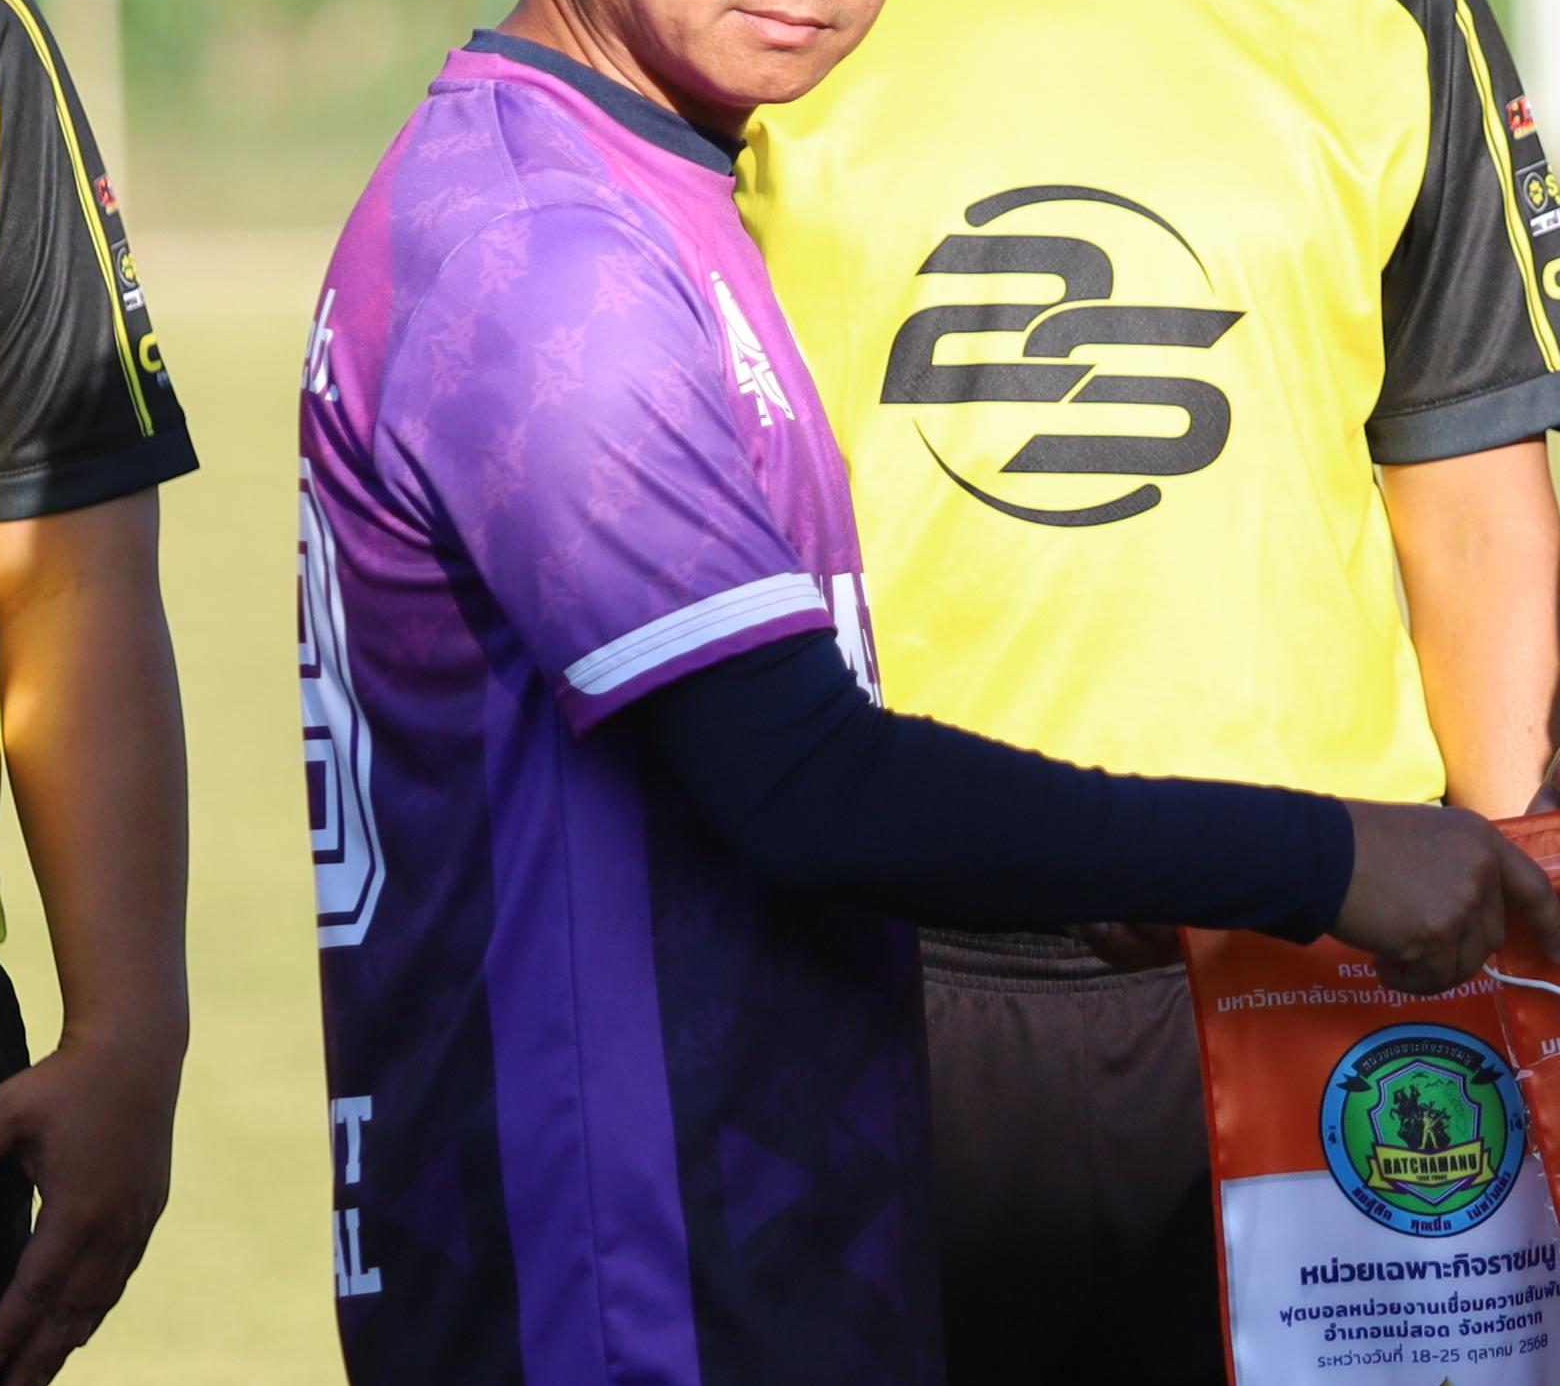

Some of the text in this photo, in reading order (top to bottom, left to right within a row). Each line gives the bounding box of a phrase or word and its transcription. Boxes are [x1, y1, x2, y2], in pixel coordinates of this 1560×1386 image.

[1382, 1153, 1478, 1175] RATCHAMANU
[1300, 1242, 1556, 1286] หน่วยเฉพาะกิจราชมนู
[1324, 1311, 1543, 1342] อำเภอแม่สอด จังหวัดตาก
[1317, 1334, 1549, 1368] ระหว่างวันที่ 18-25 ตุลาคม 2568
